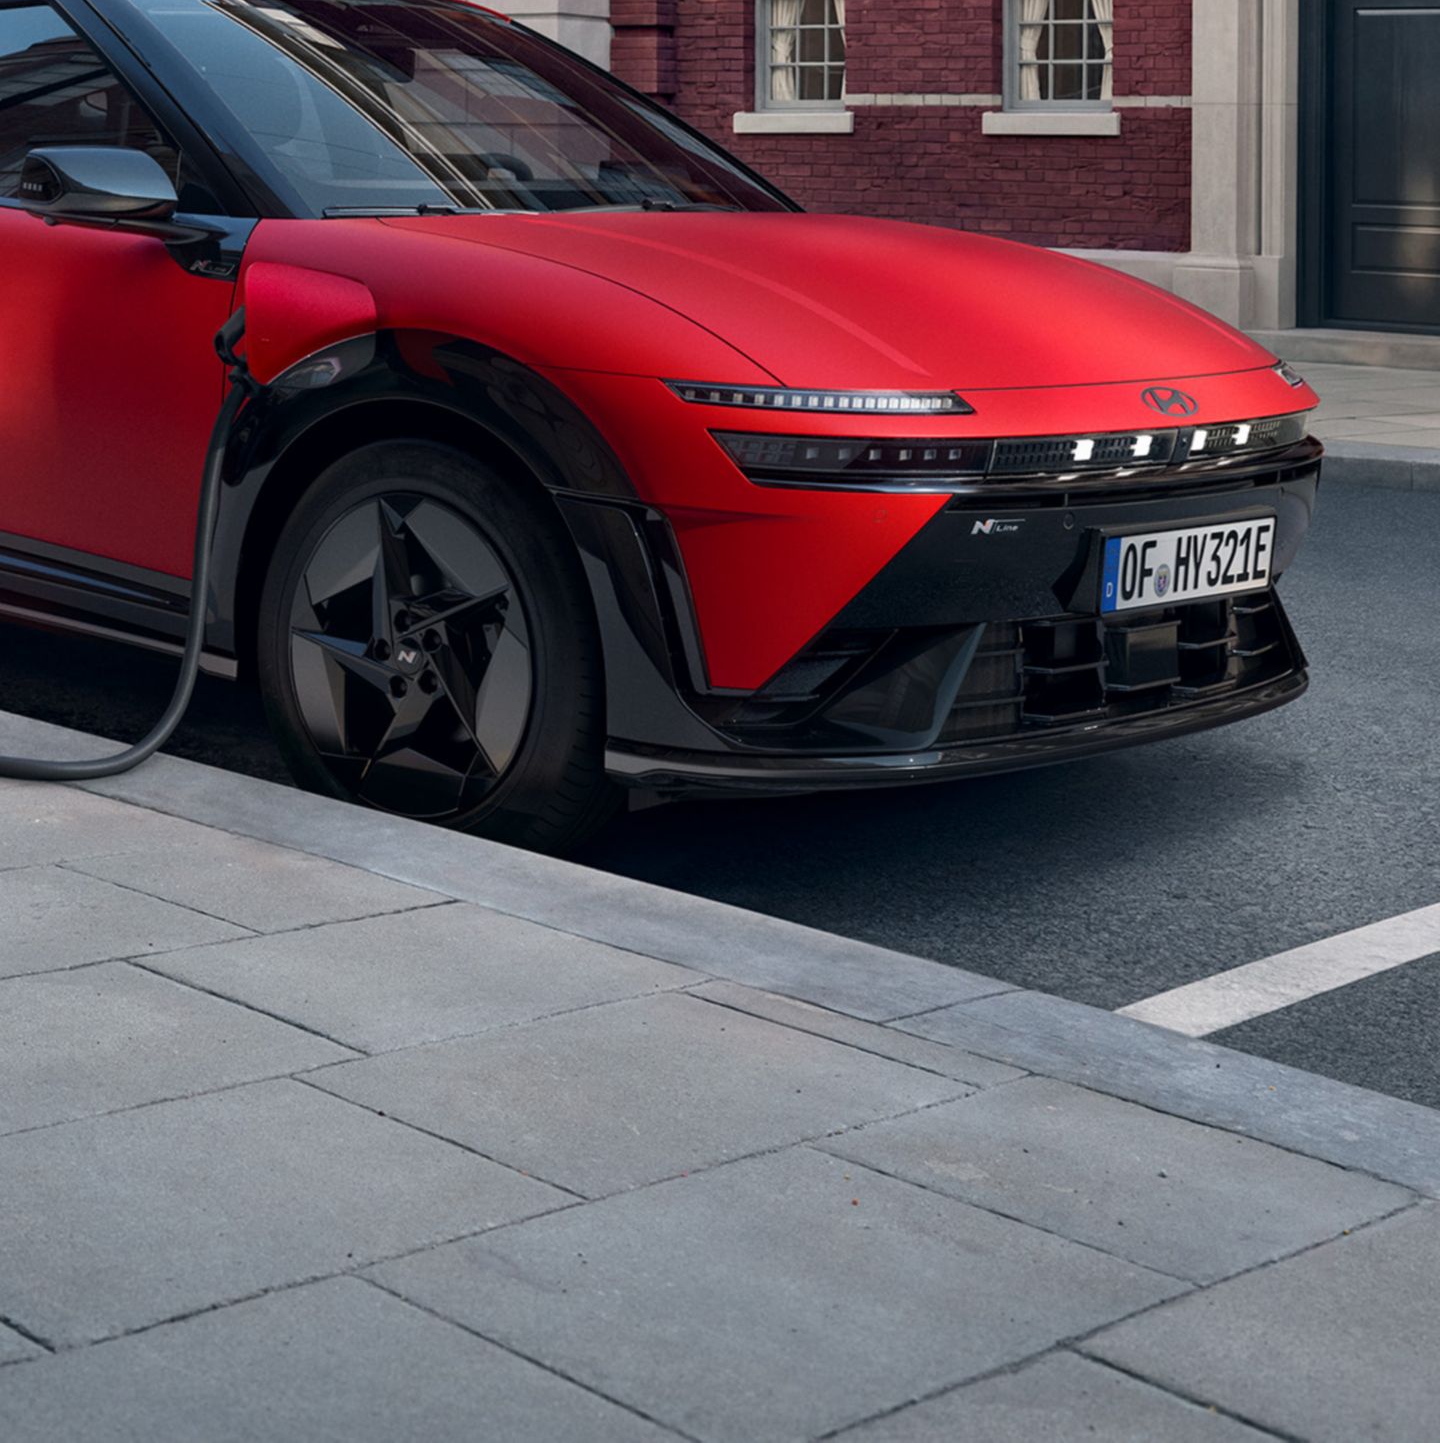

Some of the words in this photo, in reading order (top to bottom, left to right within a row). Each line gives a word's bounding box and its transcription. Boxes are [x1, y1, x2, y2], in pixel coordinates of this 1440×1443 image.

[971, 519, 995, 535] N
[996, 524, 1019, 533] Line
[1121, 540, 1158, 601] OF
[1173, 525, 1271, 593] HY321E
[1105, 582, 1113, 598] D
